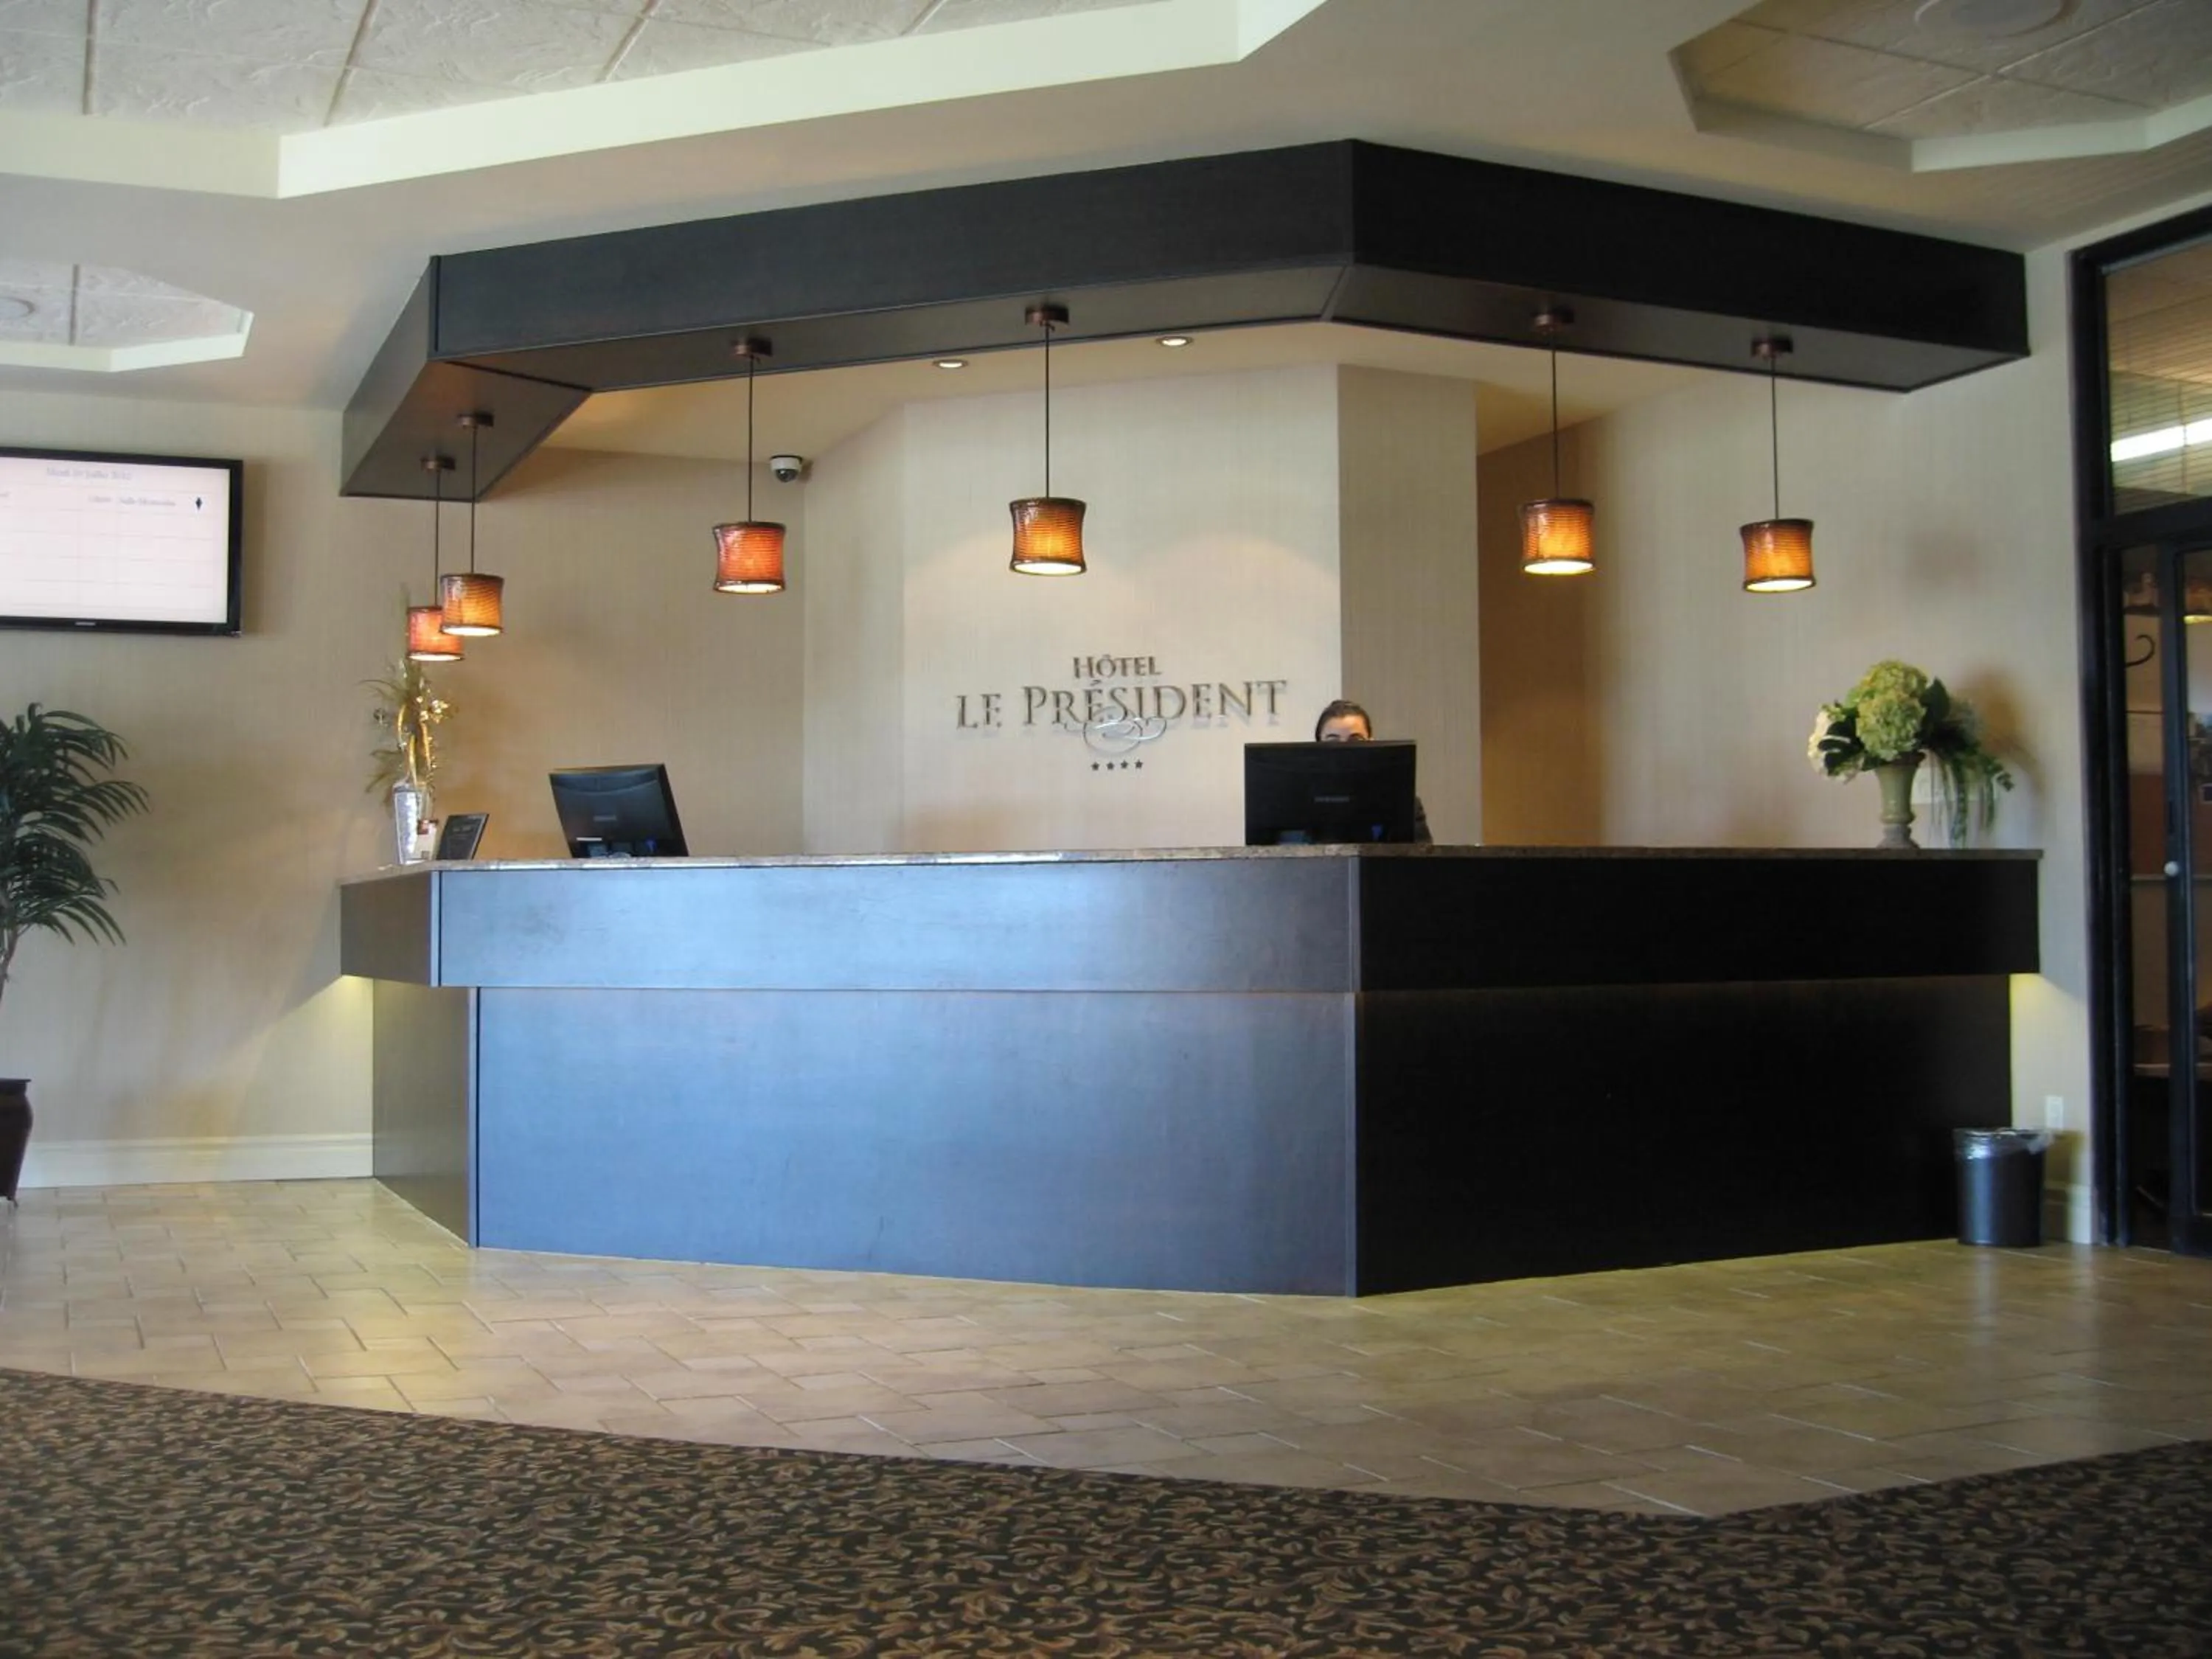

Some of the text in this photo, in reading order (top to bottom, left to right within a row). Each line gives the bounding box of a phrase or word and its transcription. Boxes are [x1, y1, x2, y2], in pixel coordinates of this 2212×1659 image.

[1073, 654, 1163, 679] HÔTEL
[955, 679, 1288, 728] LE PRÉSIDENT
